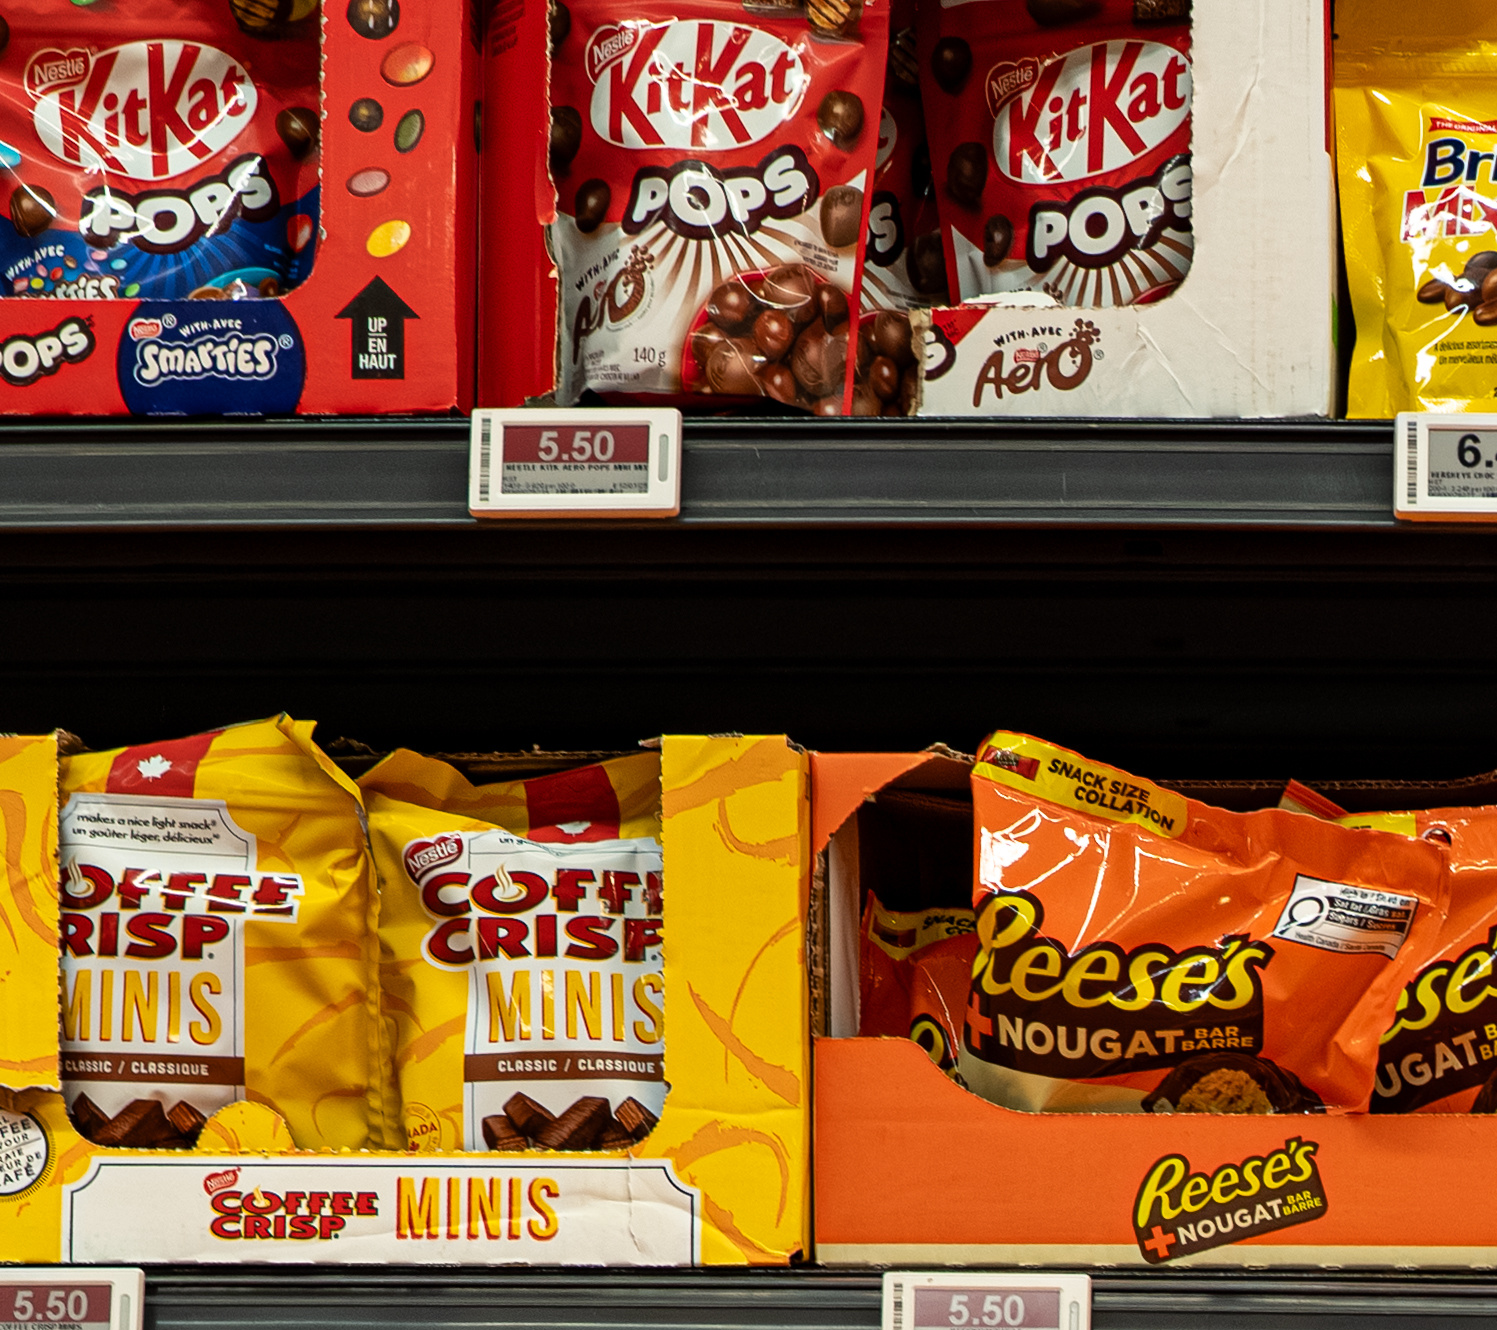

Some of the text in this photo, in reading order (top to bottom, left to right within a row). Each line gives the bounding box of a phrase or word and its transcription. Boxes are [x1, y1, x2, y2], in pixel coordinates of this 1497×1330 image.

[368, 318, 387, 332] UP
[369, 338, 387, 352] EN
[360, 355, 396, 369] HAUT
[537, 431, 615, 462] 5.50
[1048, 759, 1150, 801] SNACK SIZE
[1075, 787, 1175, 830] COLLATION
[1139, 1139, 1319, 1229] Reese's
[209, 1177, 560, 1241] COFFEE MINIS
[1177, 1200, 1282, 1245] NOUGAT
[211, 1213, 342, 1239] CRISP
[13, 1291, 88, 1322] 5.50
[948, 1295, 1024, 1327] 5.50
